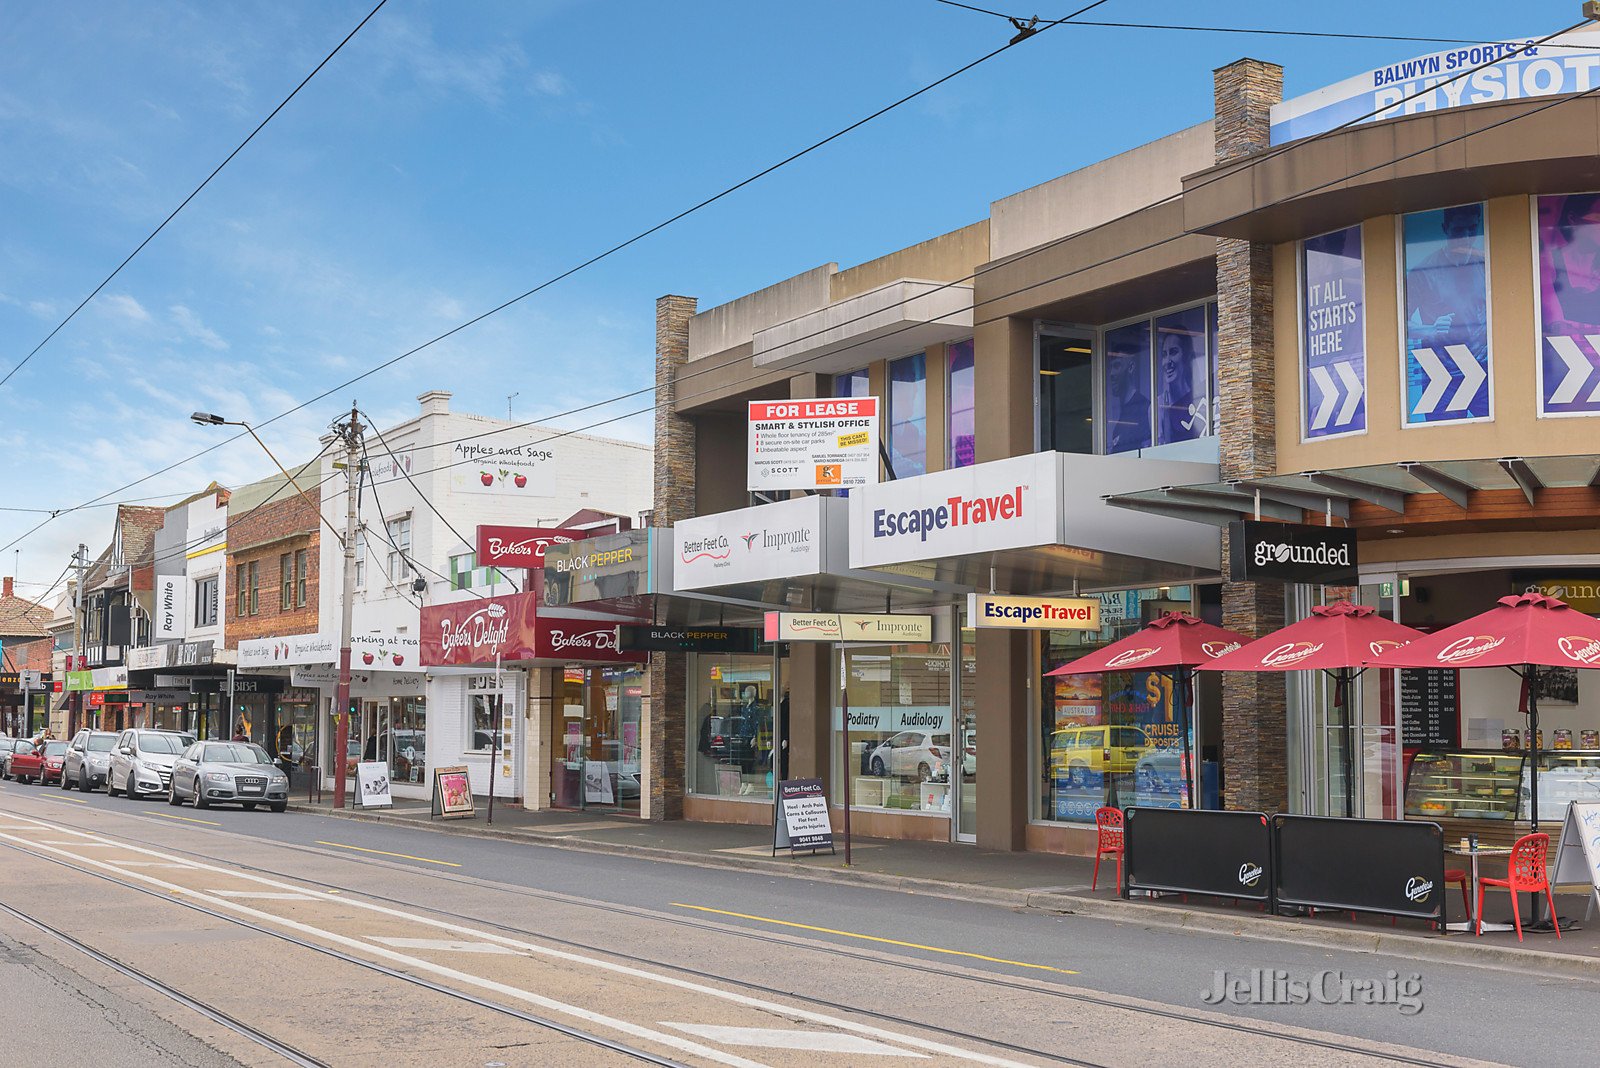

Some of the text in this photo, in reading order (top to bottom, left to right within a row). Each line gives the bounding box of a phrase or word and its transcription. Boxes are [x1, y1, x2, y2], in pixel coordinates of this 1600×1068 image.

[1373, 39, 1539, 87] BALWYN SPORTS &
[1309, 278, 1347, 307] IT ALL
[1309, 301, 1356, 332] STARTS
[1310, 330, 1343, 357] HERE
[766, 402, 858, 418] FOR LEASE
[755, 422, 786, 430] SMART
[798, 420, 835, 429] STYLISH
[838, 419, 870, 428] OFFICE
[790, 432, 811, 440] tenancy
[454, 444, 553, 461] Apples and Sage
[874, 485, 1022, 542] EscapeTravel
[488, 538, 531, 560] Bakers
[684, 535, 729, 554] Better Feet Co.
[763, 527, 810, 550] Impronte
[790, 545, 810, 554] Audiology
[1254, 540, 1350, 567] grounded
[556, 548, 633, 573] BLACK PEPPER
[163, 581, 174, 631] Ray White
[984, 602, 1091, 623] EscapeTravel
[687, 632, 728, 640] PEPPER
[877, 620, 922, 633] Impronte
[350, 636, 384, 646] arking
[388, 636, 398, 644] at
[441, 616, 509, 660] Bakers Delight
[550, 630, 592, 651] Bakers
[1146, 672, 1174, 722] $1
[847, 712, 944, 729] Podiatry Audiology
[1063, 706, 1094, 715] AUSTRALIA
[1144, 724, 1179, 736] CRUISE
[1144, 737, 1180, 747] DEPOSITS
[1238, 862, 1263, 886] Genovese
[1405, 876, 1433, 902] Genovese
